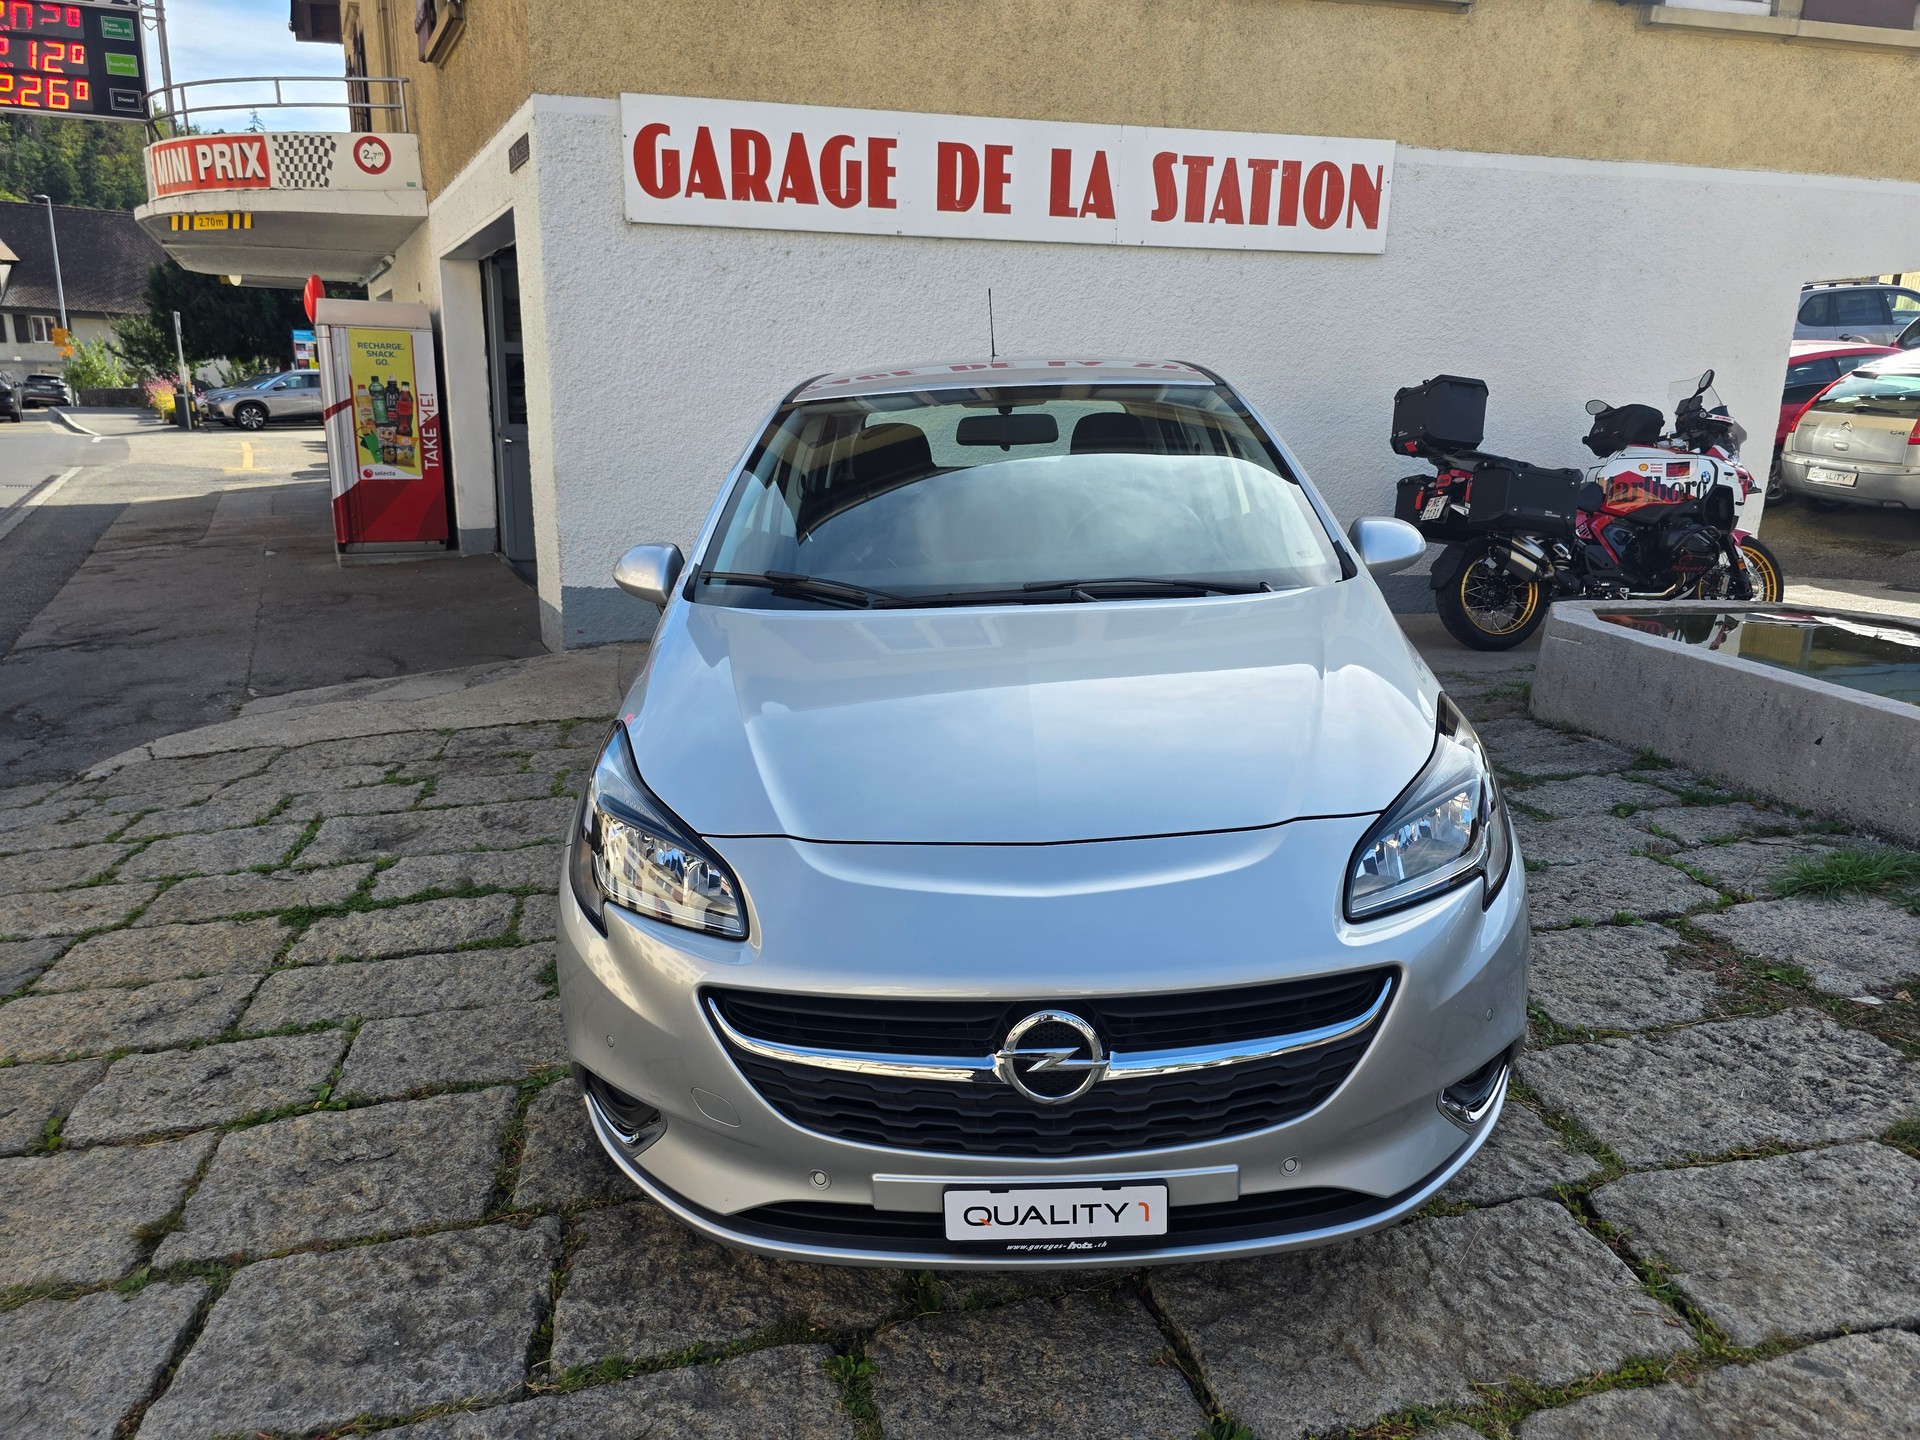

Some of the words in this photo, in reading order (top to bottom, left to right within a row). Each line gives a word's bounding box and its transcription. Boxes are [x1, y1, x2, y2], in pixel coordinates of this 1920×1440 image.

[154, 146, 193, 187] MINI
[195, 141, 267, 181] PRIX
[633, 122, 898, 209] GARAGE
[937, 141, 1014, 216] DE
[1049, 147, 1116, 220] LA
[1151, 151, 1384, 231] STATION
[357, 341, 405, 351] RECHARGE.
[366, 350, 398, 359] SNACK.
[375, 358, 390, 367] GO.
[420, 393, 435, 424] ME!
[422, 427, 440, 471] TAKE
[1811, 471, 1848, 482] QUALITY
[963, 1202, 1130, 1227] QUALITY
[1138, 1202, 1150, 1222] 1
